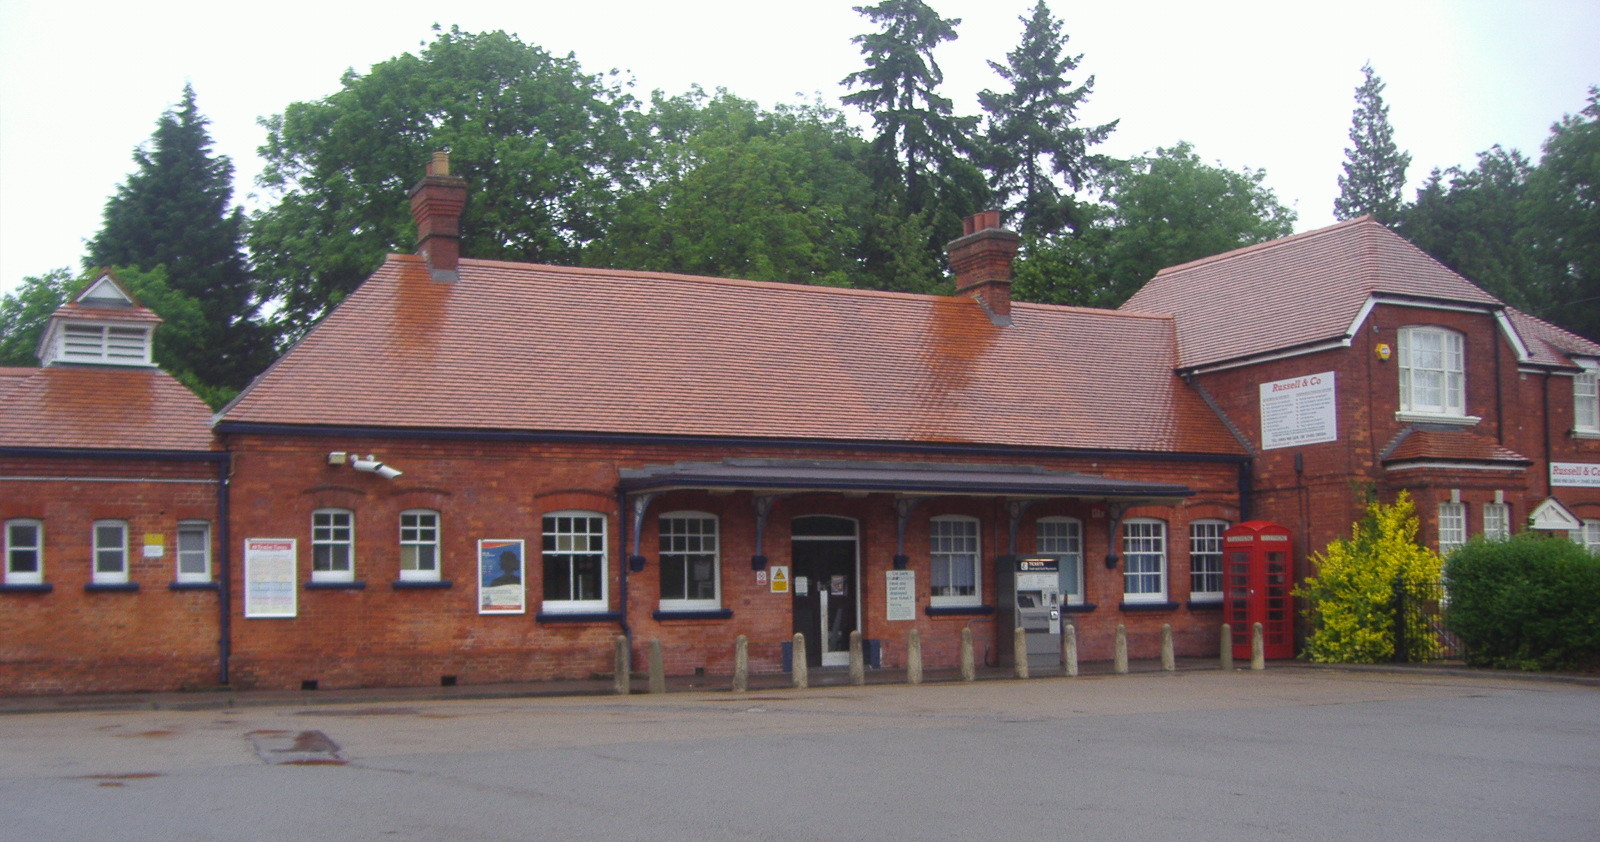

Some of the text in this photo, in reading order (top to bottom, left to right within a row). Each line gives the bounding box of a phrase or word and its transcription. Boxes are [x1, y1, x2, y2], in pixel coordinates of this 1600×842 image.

[1272, 377, 1321, 392] Russell & Co
[1553, 466, 1581, 475] Russell
[1583, 466, 1588, 475] &
